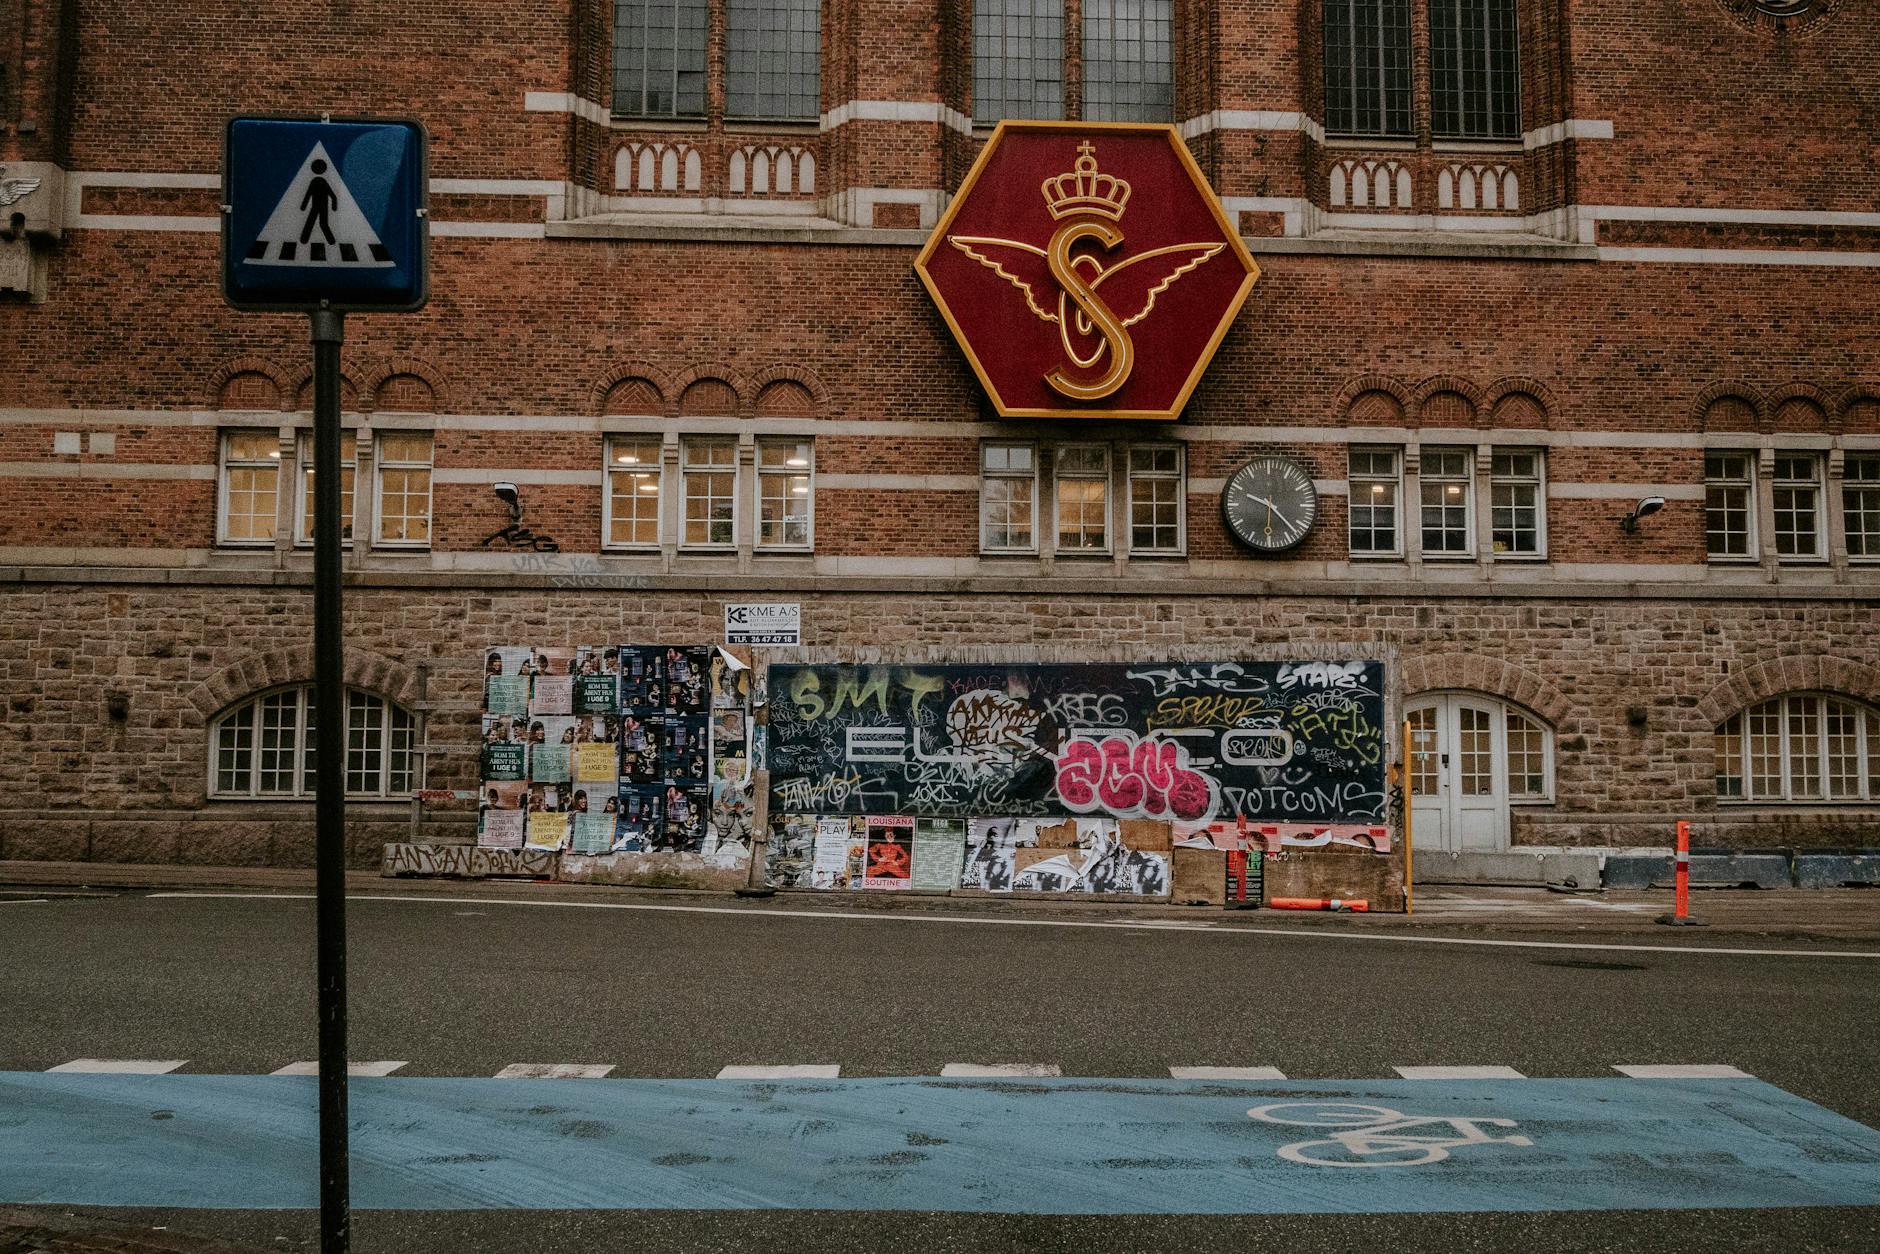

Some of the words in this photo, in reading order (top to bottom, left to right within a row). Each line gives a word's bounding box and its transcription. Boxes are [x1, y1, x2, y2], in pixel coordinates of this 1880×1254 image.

[749, 607, 775, 616] KME
[780, 607, 798, 616] A/S
[868, 817, 914, 825] LOUISIANA
[820, 826, 846, 835] PLAY
